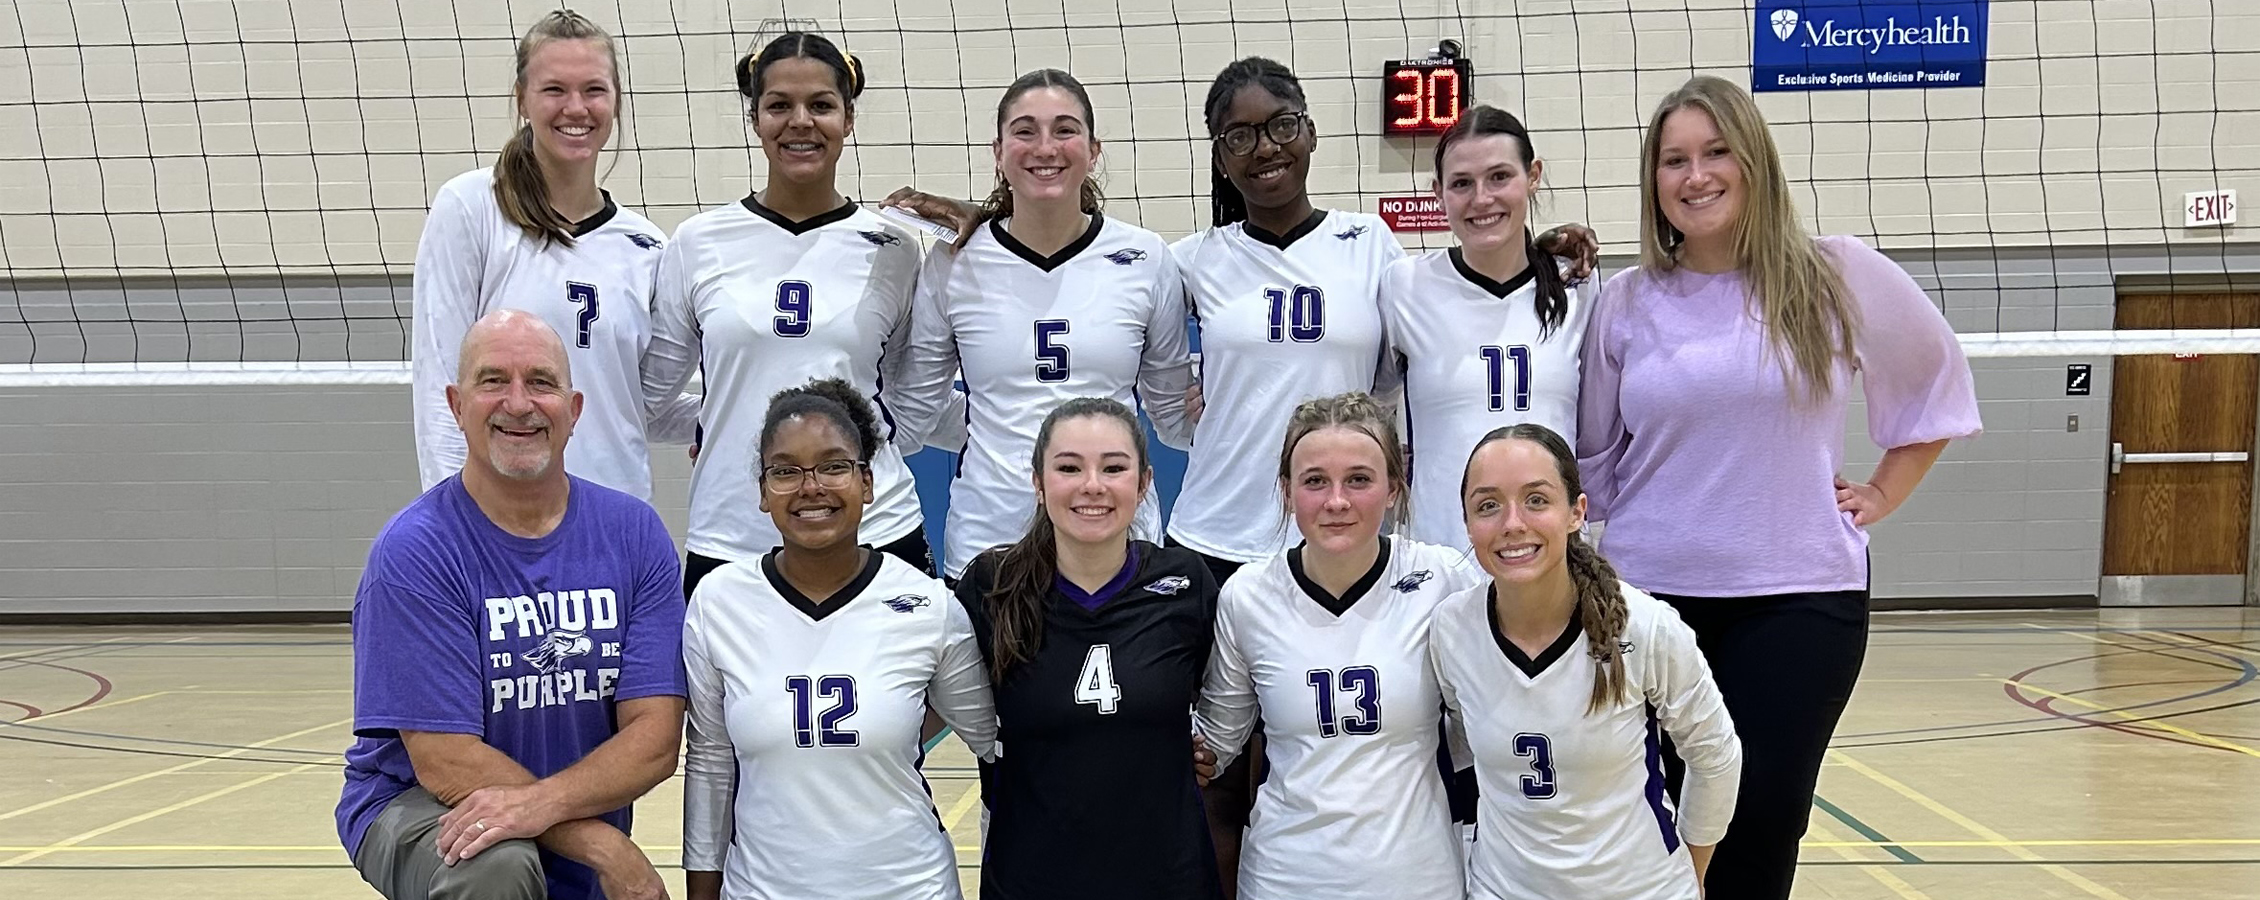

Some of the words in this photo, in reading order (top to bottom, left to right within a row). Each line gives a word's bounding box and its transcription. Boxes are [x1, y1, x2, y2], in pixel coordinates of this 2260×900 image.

[1801, 16, 1970, 54] Mercyhealth
[1394, 68, 1459, 127] 30
[1778, 73, 1827, 85] Exclusive
[1830, 73, 1863, 84] Sports
[1867, 71, 1914, 83] Medicine
[1917, 70, 1961, 82] Provider
[1382, 201, 1403, 212] NO
[2195, 195, 2230, 221] EXIT
[566, 281, 599, 348] 7
[773, 280, 812, 337] 9
[1264, 285, 1325, 343] 10
[1034, 319, 1070, 383] 5
[1480, 345, 1531, 412] 11
[485, 588, 618, 641] PROUD
[490, 653, 512, 668] TO
[601, 642, 620, 657] BE
[491, 668, 620, 713] PURPLE
[1075, 644, 1121, 714] 4
[1306, 665, 1381, 738] 13
[786, 674, 860, 748] 12
[1513, 732, 1558, 800] 3
